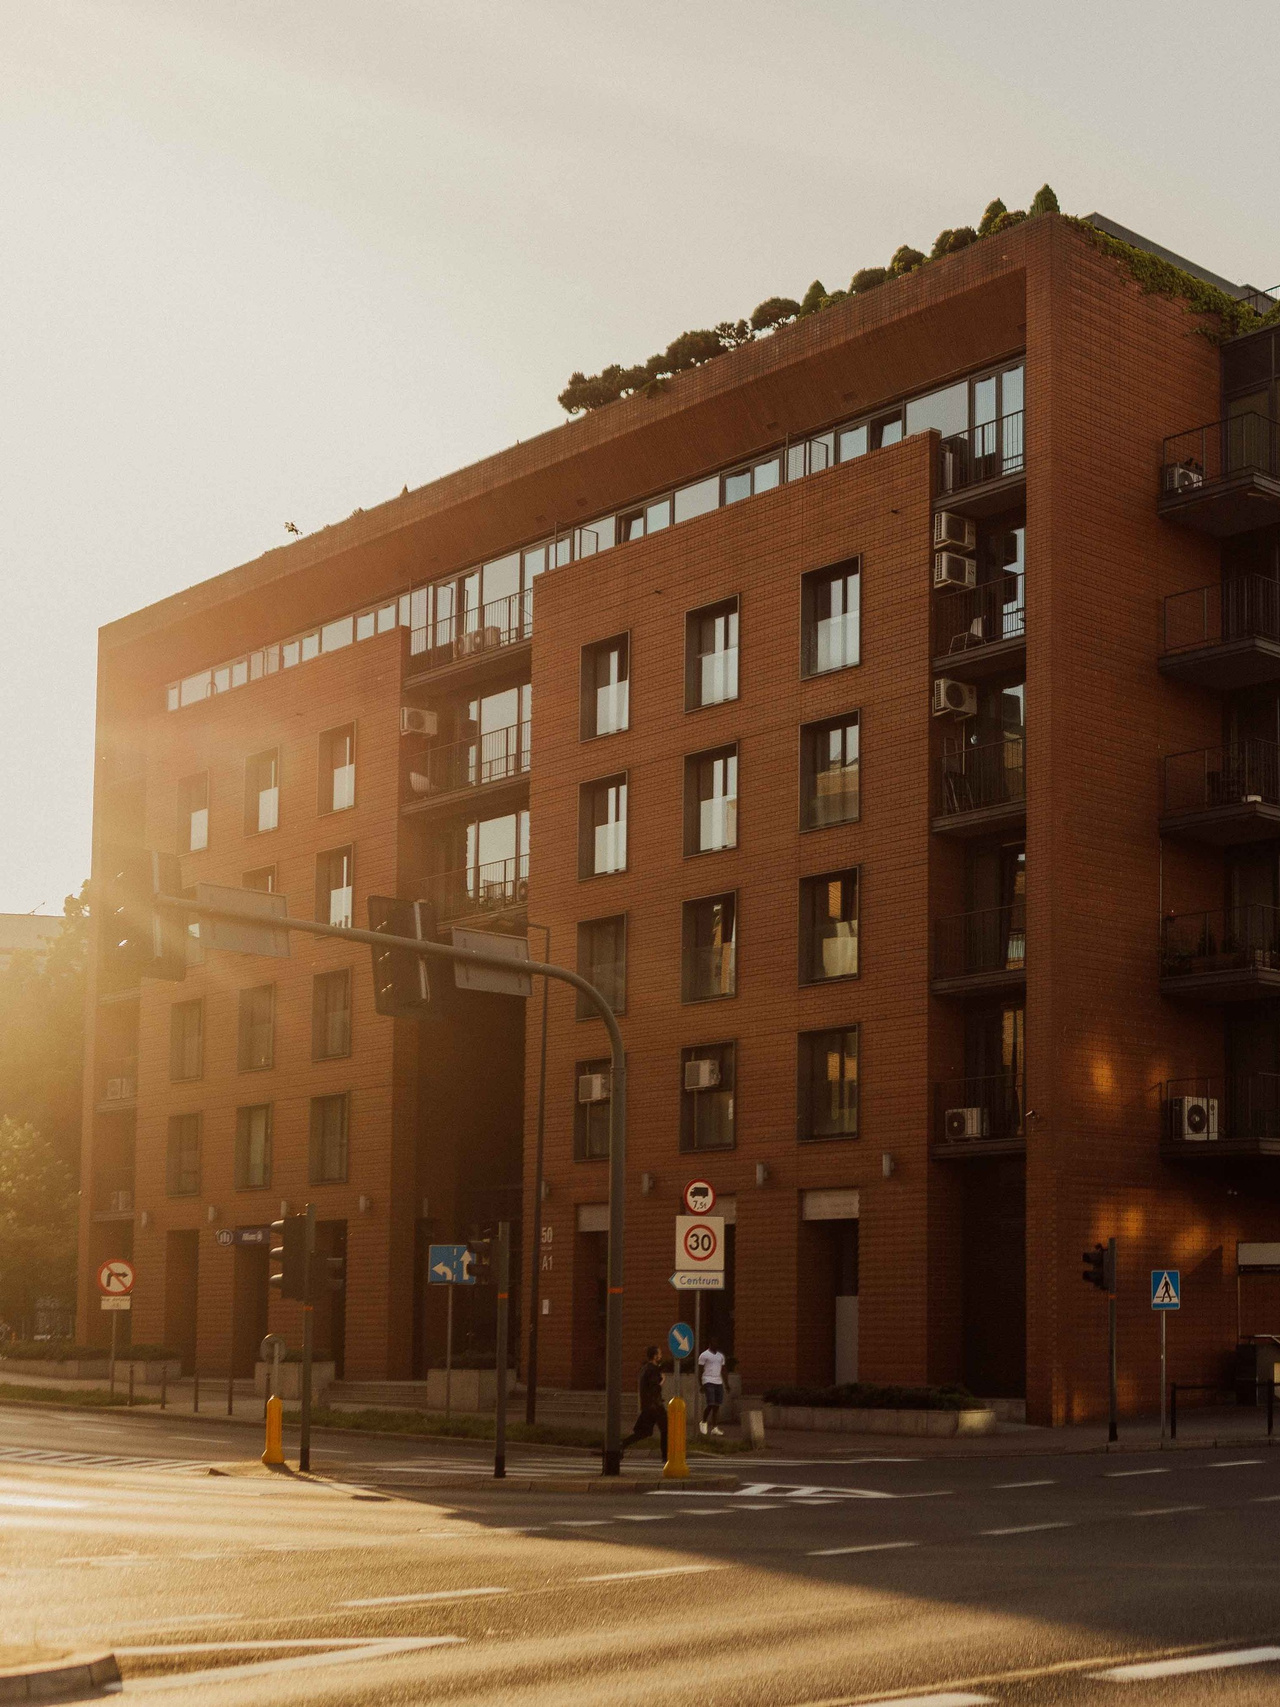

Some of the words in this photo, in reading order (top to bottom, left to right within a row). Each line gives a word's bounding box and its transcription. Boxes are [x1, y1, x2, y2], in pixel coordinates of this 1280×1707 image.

[541, 1227, 553, 1243] 50
[688, 1233, 712, 1252] 30
[541, 1255, 553, 1270] A1
[679, 1275, 720, 1286] Centrum
